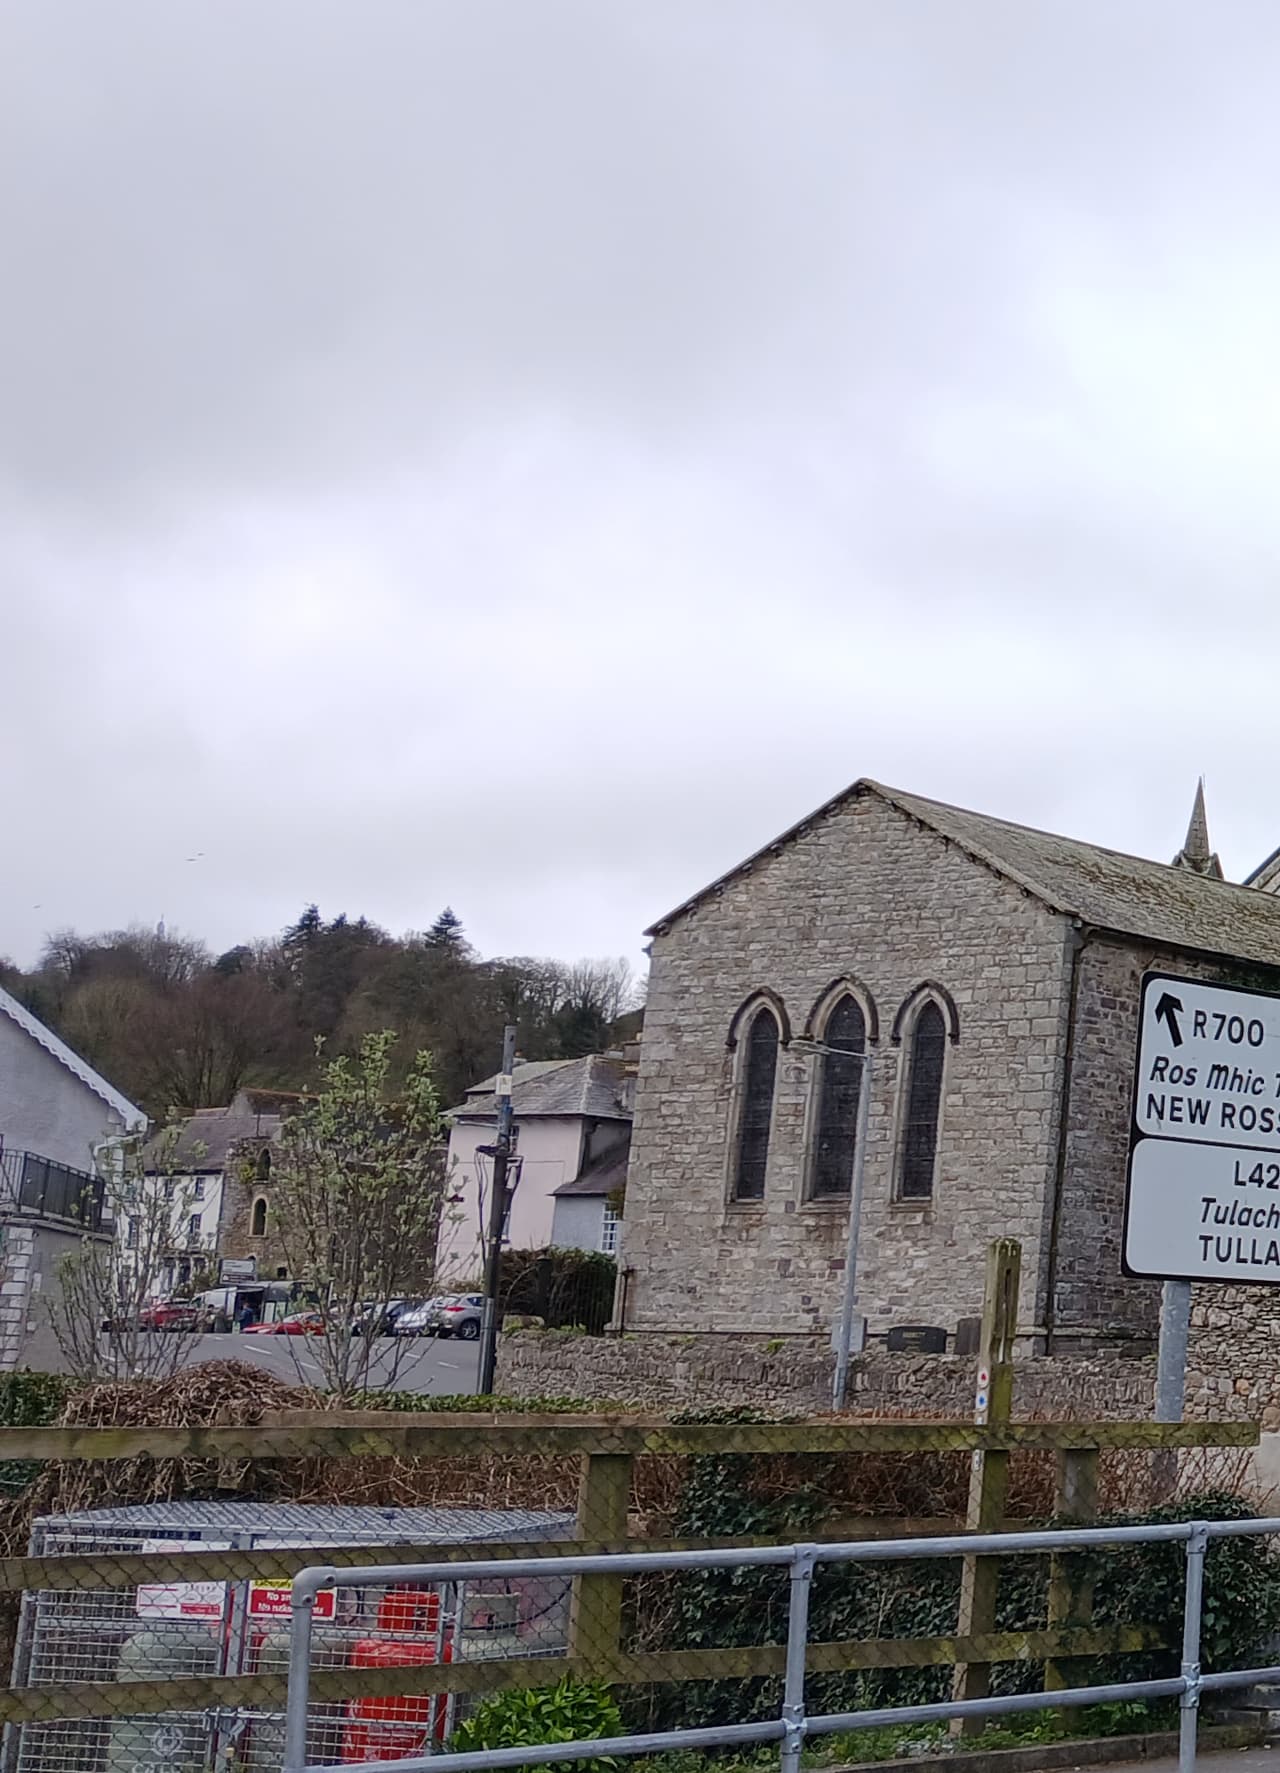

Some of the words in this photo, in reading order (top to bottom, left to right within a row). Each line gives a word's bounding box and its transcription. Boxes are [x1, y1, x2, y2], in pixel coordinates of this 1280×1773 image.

[1193, 1010, 1264, 1047] R700
[1150, 1056, 1197, 1086] Ros
[1206, 1063, 1265, 1095] Mhic
[1147, 1093, 1211, 1125] NEW
